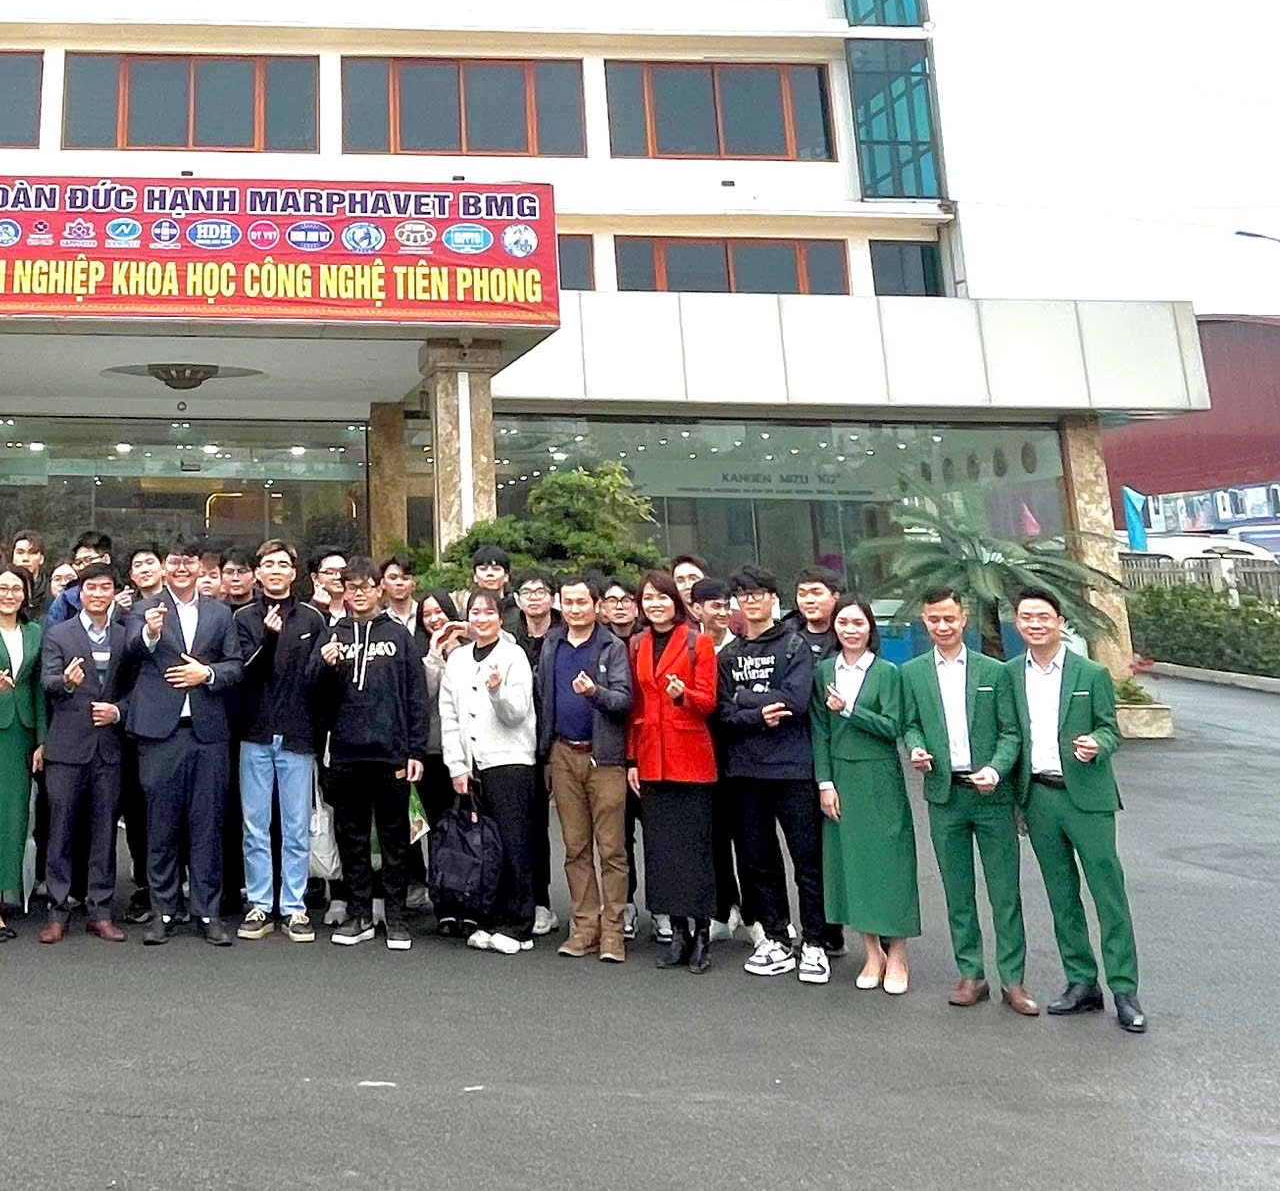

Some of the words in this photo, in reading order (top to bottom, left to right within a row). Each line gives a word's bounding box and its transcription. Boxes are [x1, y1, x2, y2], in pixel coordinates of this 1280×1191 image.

[65, 178, 137, 212] ĐỨC
[145, 185, 238, 217] HẠNH
[247, 187, 454, 218] MARPHAVET
[459, 193, 540, 218] BMG
[196, 224, 232, 239] HDH
[13, 253, 106, 302] NGHIỆP
[112, 261, 179, 296] KHOA
[186, 262, 236, 304] HỌC
[244, 255, 312, 298] CÔNG
[319, 258, 386, 307] NGHỆ
[392, 259, 449, 301] TIÊN
[456, 267, 543, 303] PHONG
